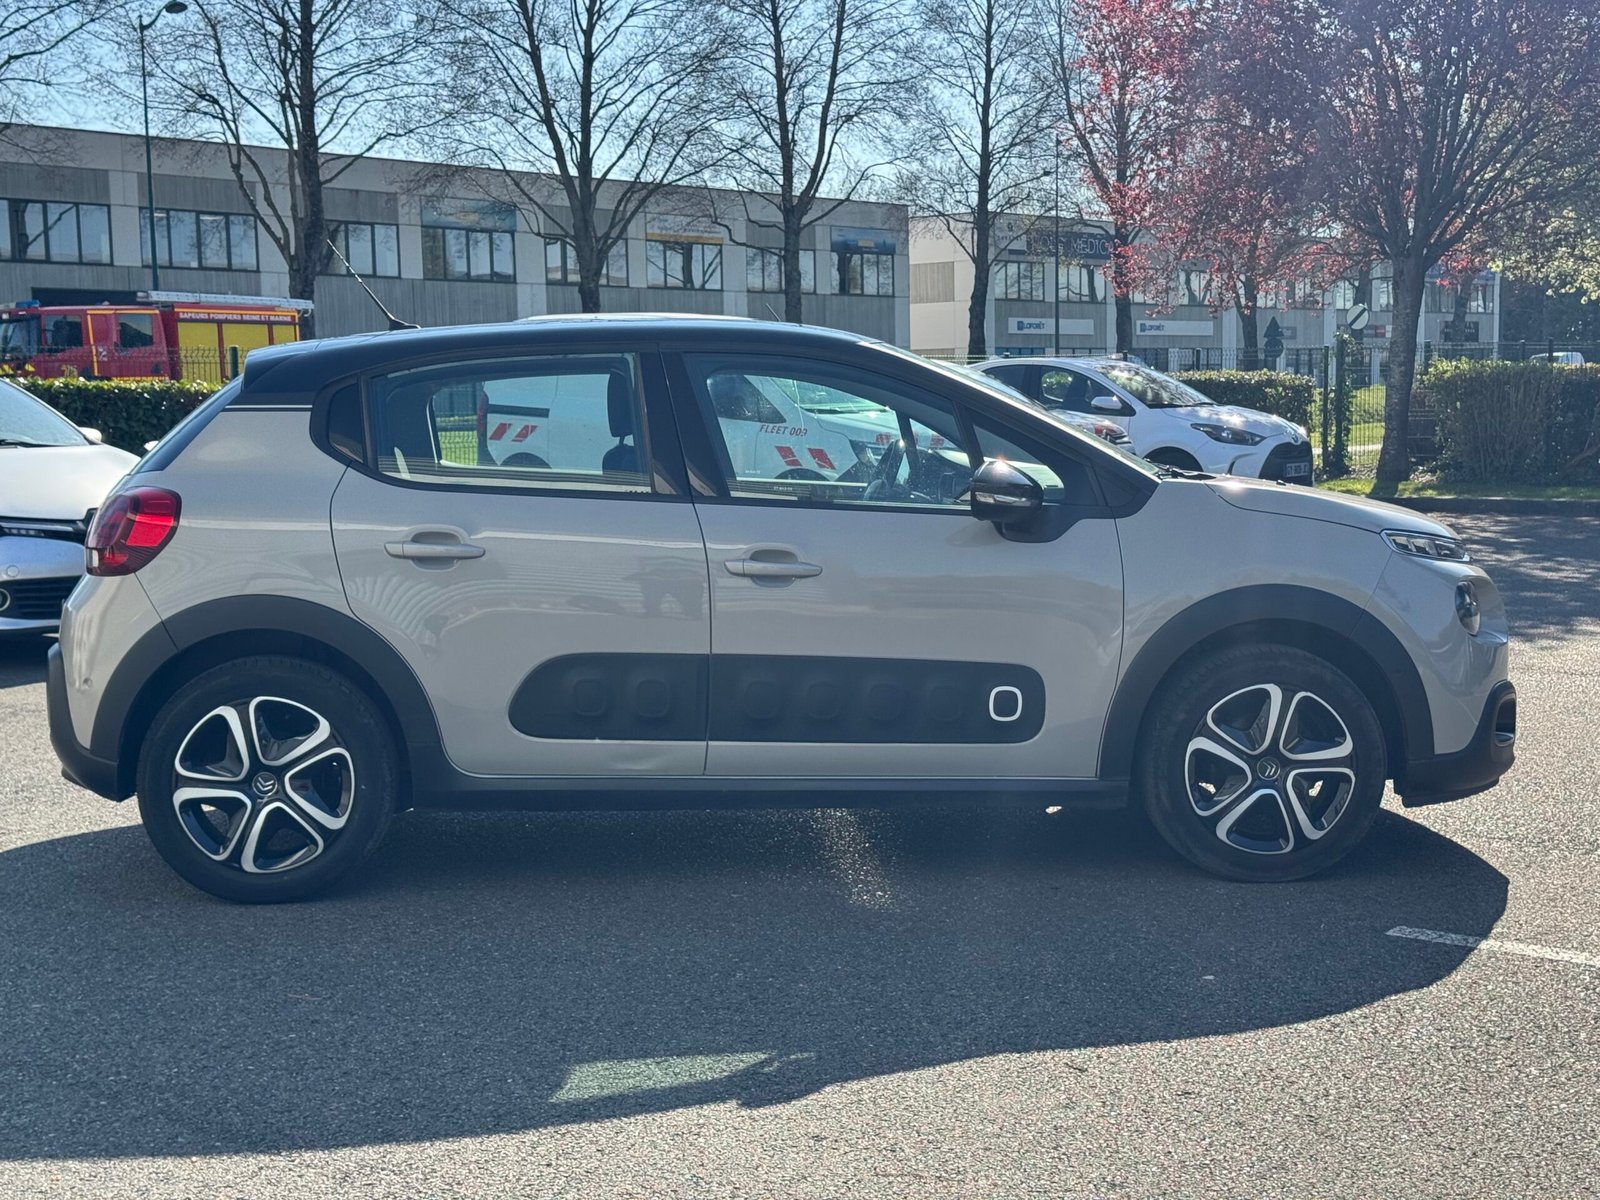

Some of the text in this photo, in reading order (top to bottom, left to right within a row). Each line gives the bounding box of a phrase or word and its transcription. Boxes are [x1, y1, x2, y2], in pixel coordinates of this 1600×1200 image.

[179, 312, 209, 320] SAPEURS
[209, 313, 241, 321] POMPIERS
[759, 424, 789, 435] FLEET
